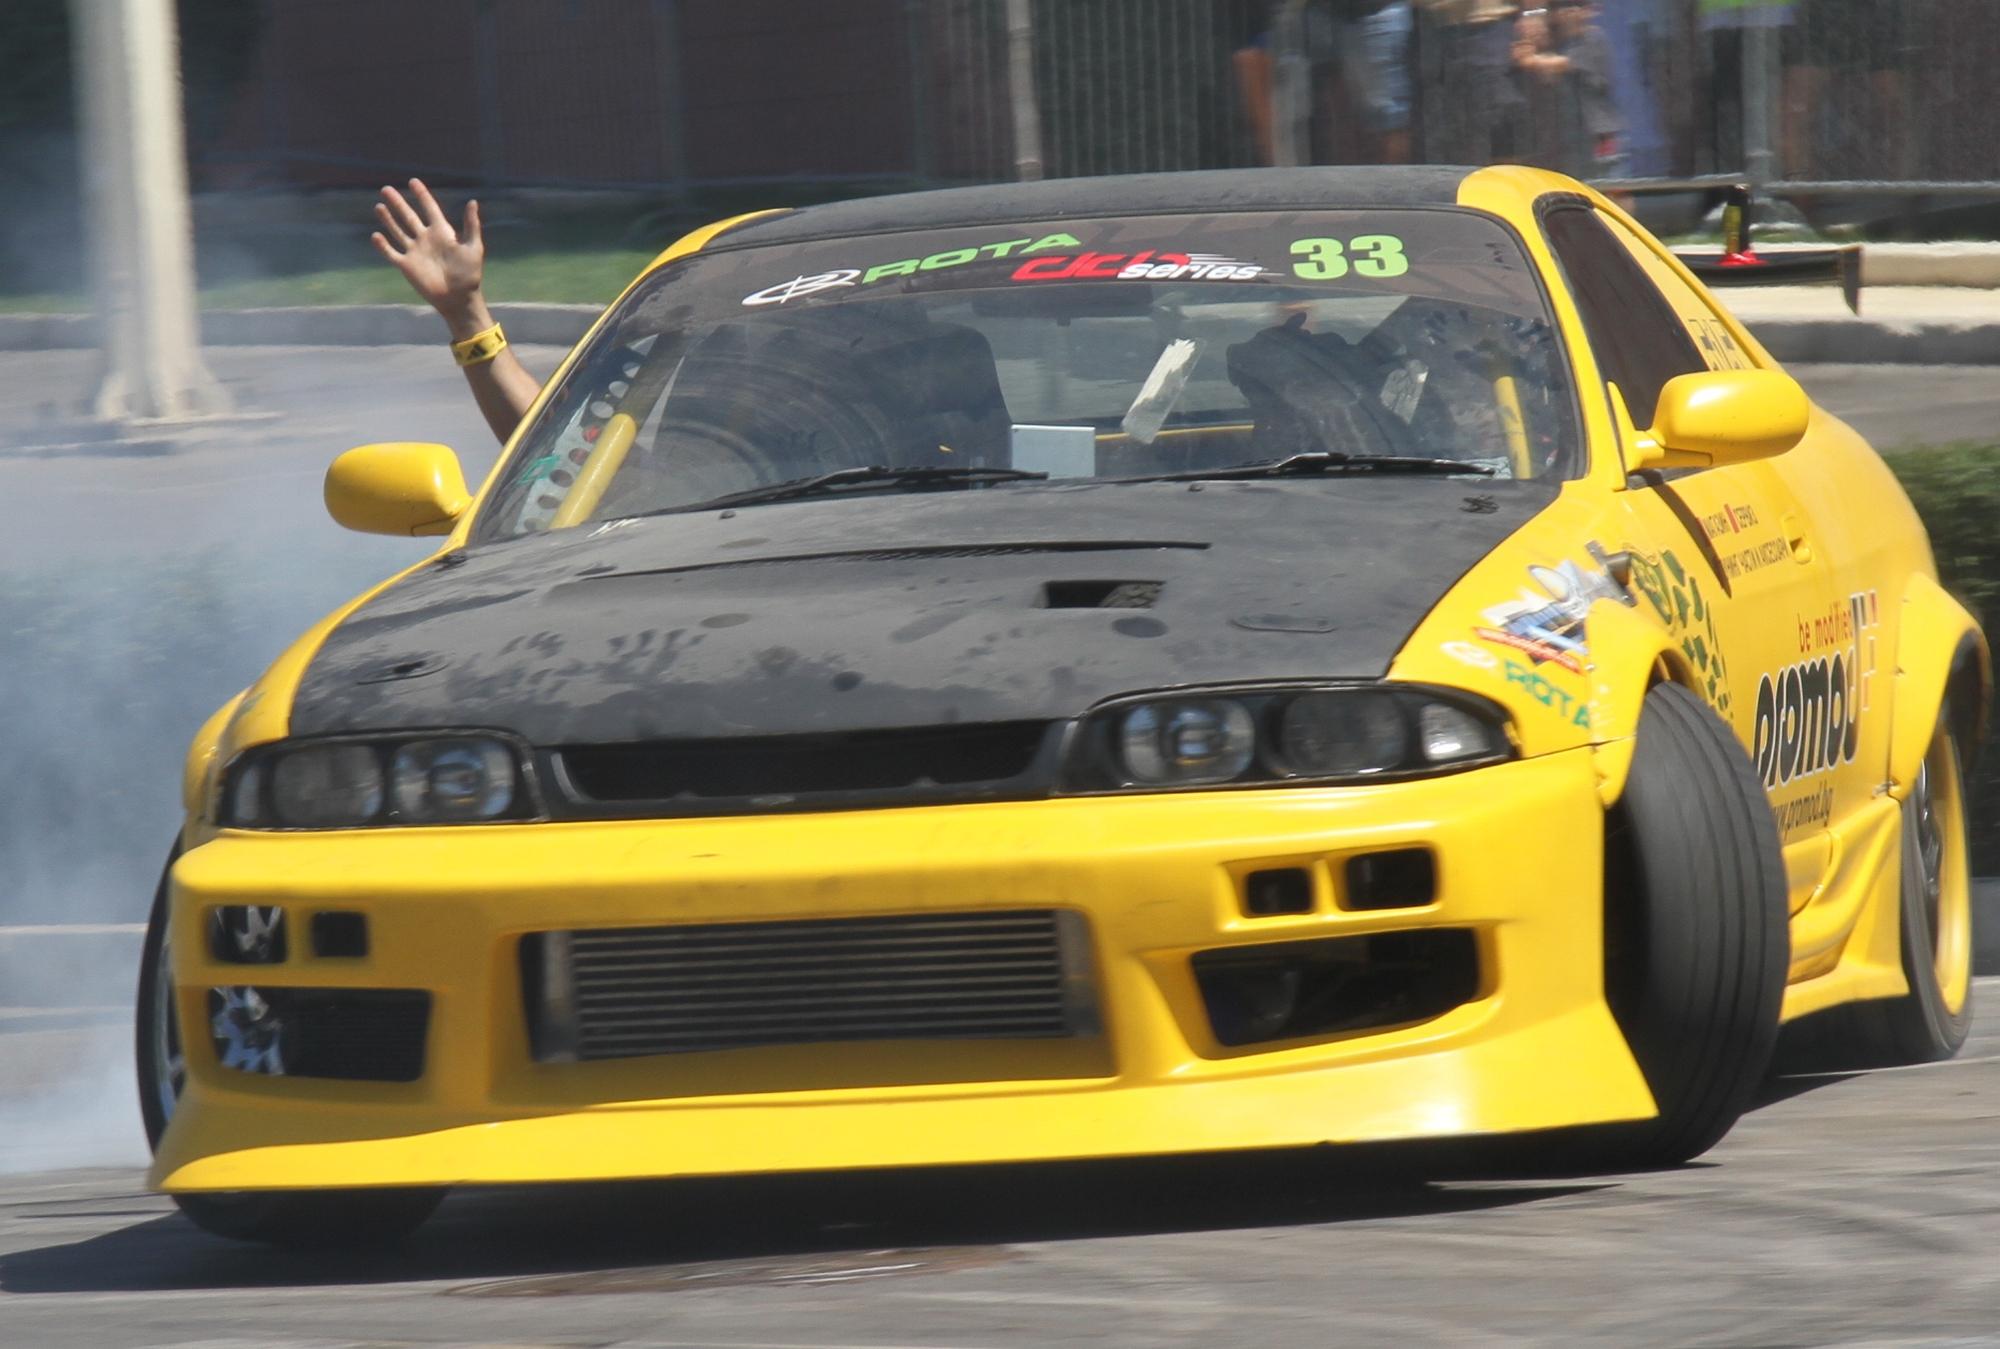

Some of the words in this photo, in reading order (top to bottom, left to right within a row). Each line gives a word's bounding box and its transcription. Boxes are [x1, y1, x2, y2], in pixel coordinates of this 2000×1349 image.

[861, 232, 1082, 285] ROTA
[1117, 262, 1264, 281] series
[1290, 234, 1409, 281] 33
[1798, 613, 1811, 653] be
[1504, 660, 1592, 729] ROTA
[1753, 600, 1860, 791] promod
